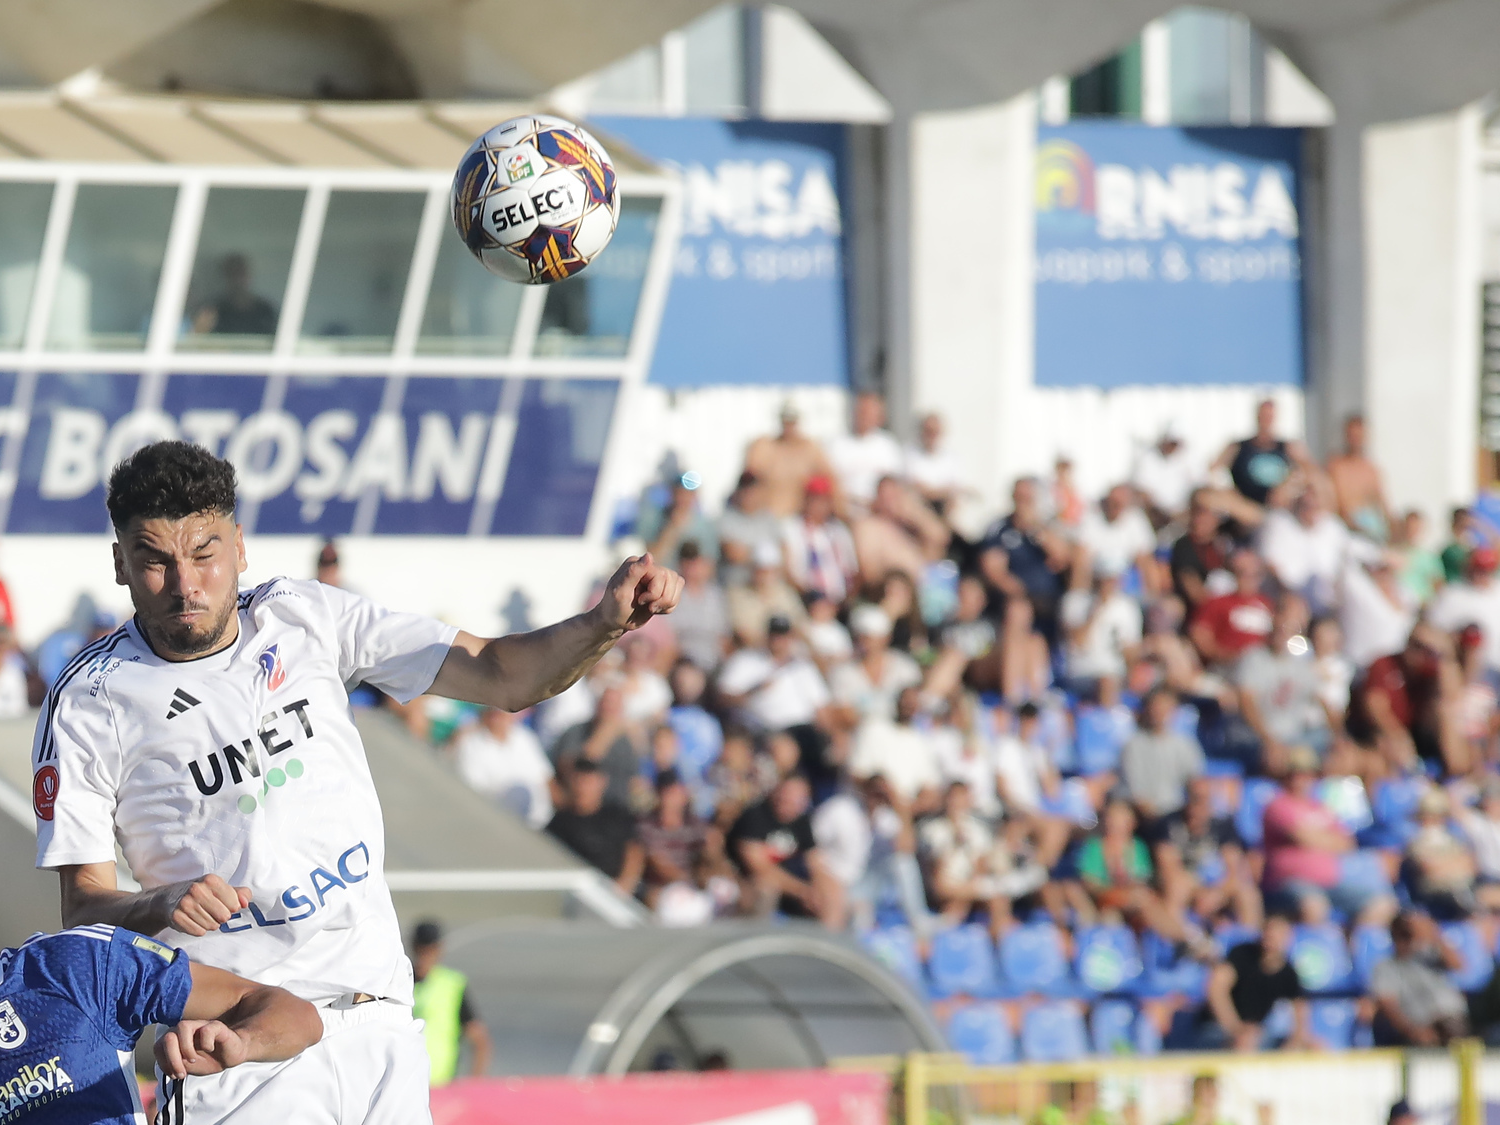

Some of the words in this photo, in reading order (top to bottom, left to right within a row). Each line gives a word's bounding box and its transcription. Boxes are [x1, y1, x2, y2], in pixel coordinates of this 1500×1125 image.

[508, 164, 532, 182] LPF
[684, 160, 841, 238] NISA
[187, 697, 315, 797] UNET
[27, 1083, 75, 1112] PROJECT
